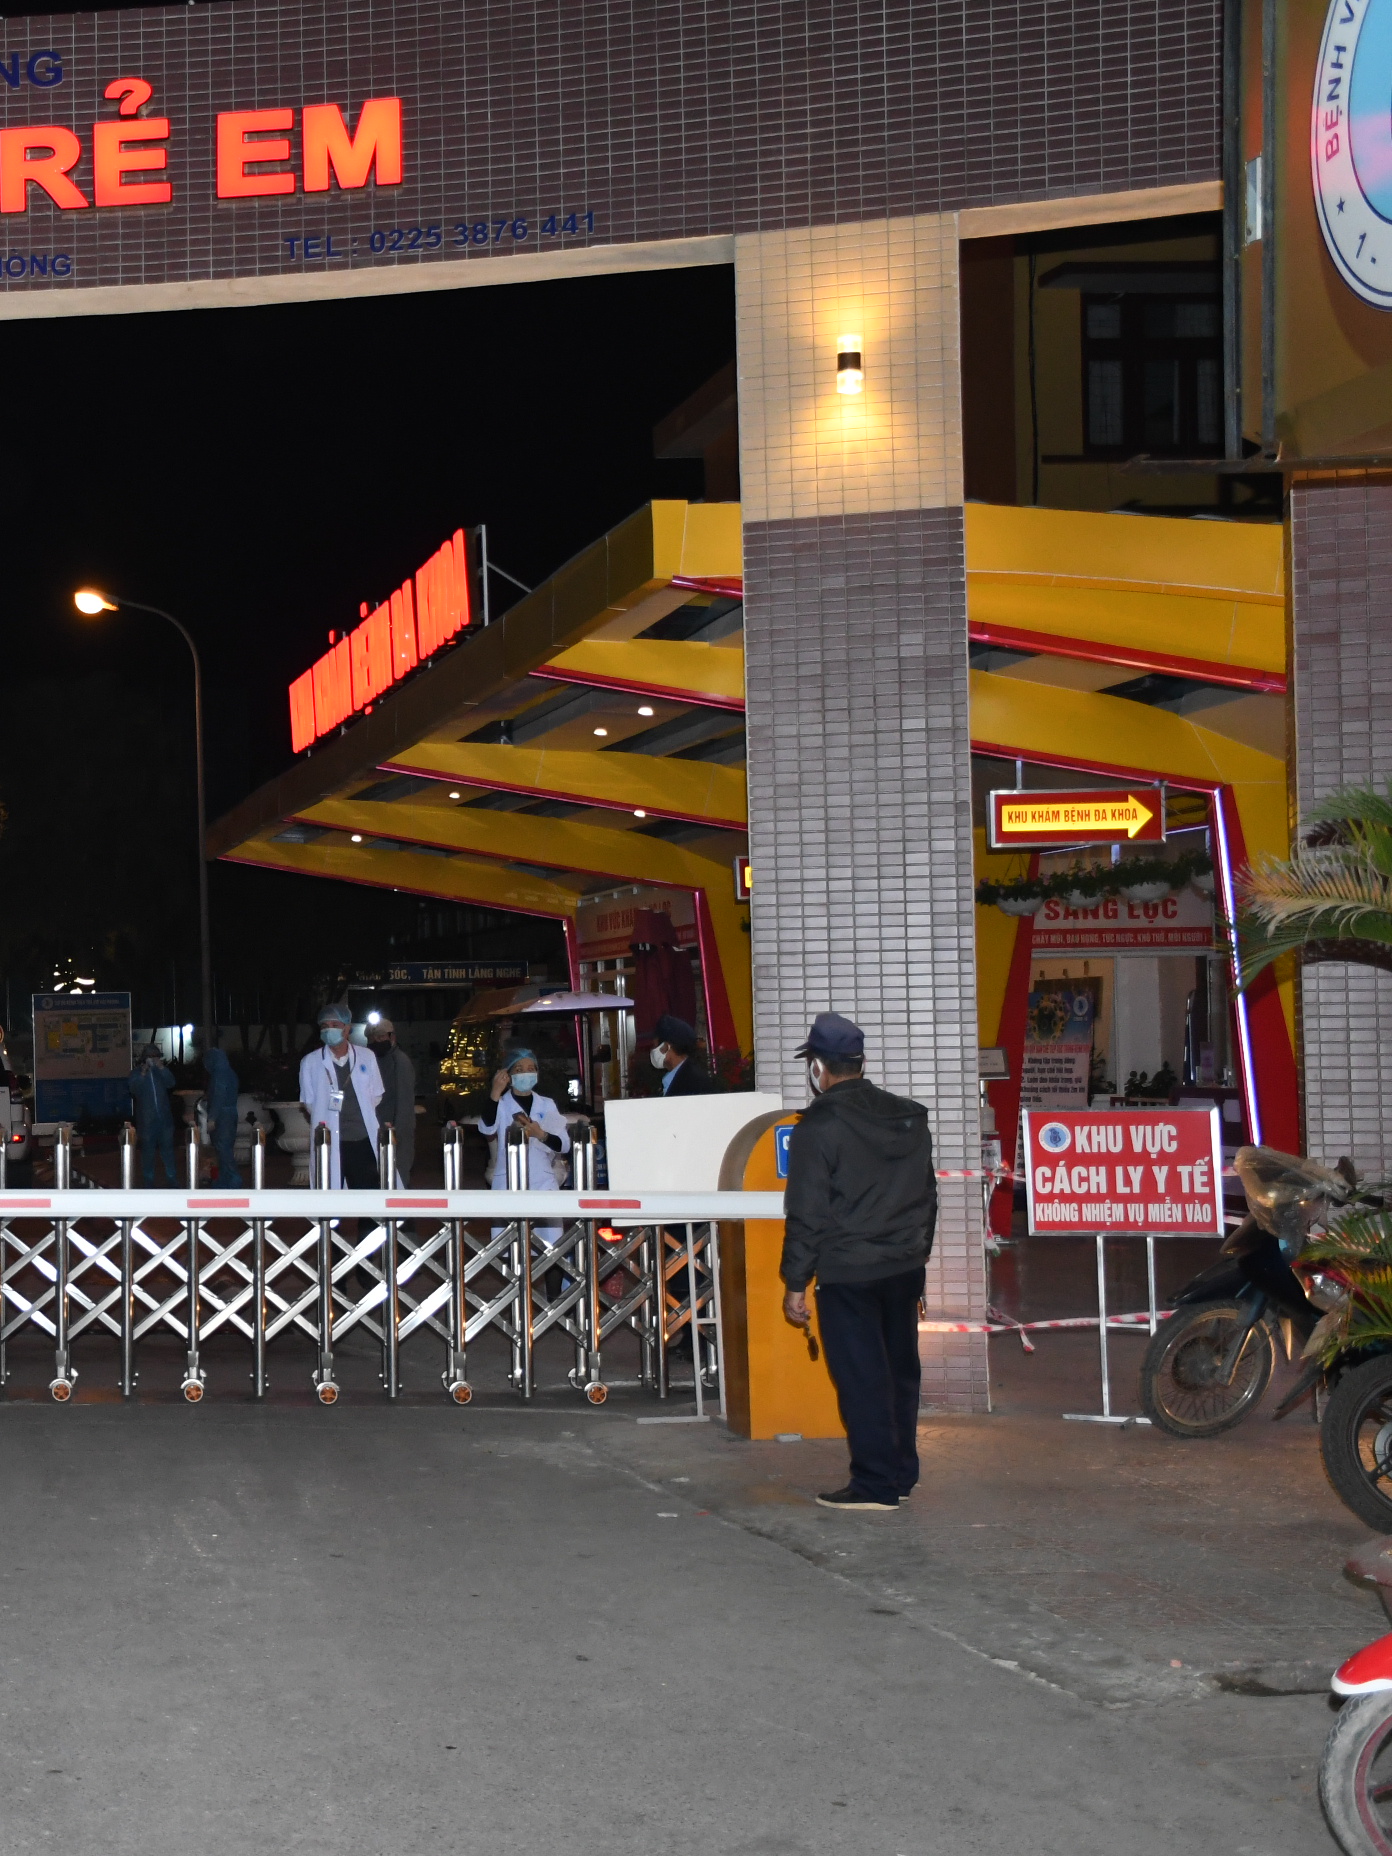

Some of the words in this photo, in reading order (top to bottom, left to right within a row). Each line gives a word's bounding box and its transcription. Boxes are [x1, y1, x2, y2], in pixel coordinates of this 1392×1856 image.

[216, 96, 404, 200] EM
[369, 225, 442, 254] 0225
[453, 217, 528, 248] 3876
[541, 210, 595, 238] 441
[1007, 810, 1028, 824] KHU
[1031, 807, 1061, 824] KHÁM
[1064, 806, 1091, 826] BỆNH
[1094, 809, 1108, 822] ĐA
[1111, 808, 1138, 822] KHOA
[1074, 1125, 1123, 1153] KHU
[1130, 1122, 1178, 1159] VỰC
[1035, 1160, 1107, 1194] CÁCH
[1115, 1165, 1144, 1194] LY
[1151, 1165, 1169, 1194] Y
[1177, 1156, 1210, 1194] TẾ
[1035, 1199, 1079, 1222] KHÔNG
[1082, 1199, 1124, 1226] NHIỆM
[1127, 1203, 1144, 1226] VỤ
[1148, 1196, 1182, 1223] MIỄN
[1185, 1200, 1212, 1223] VÀO
